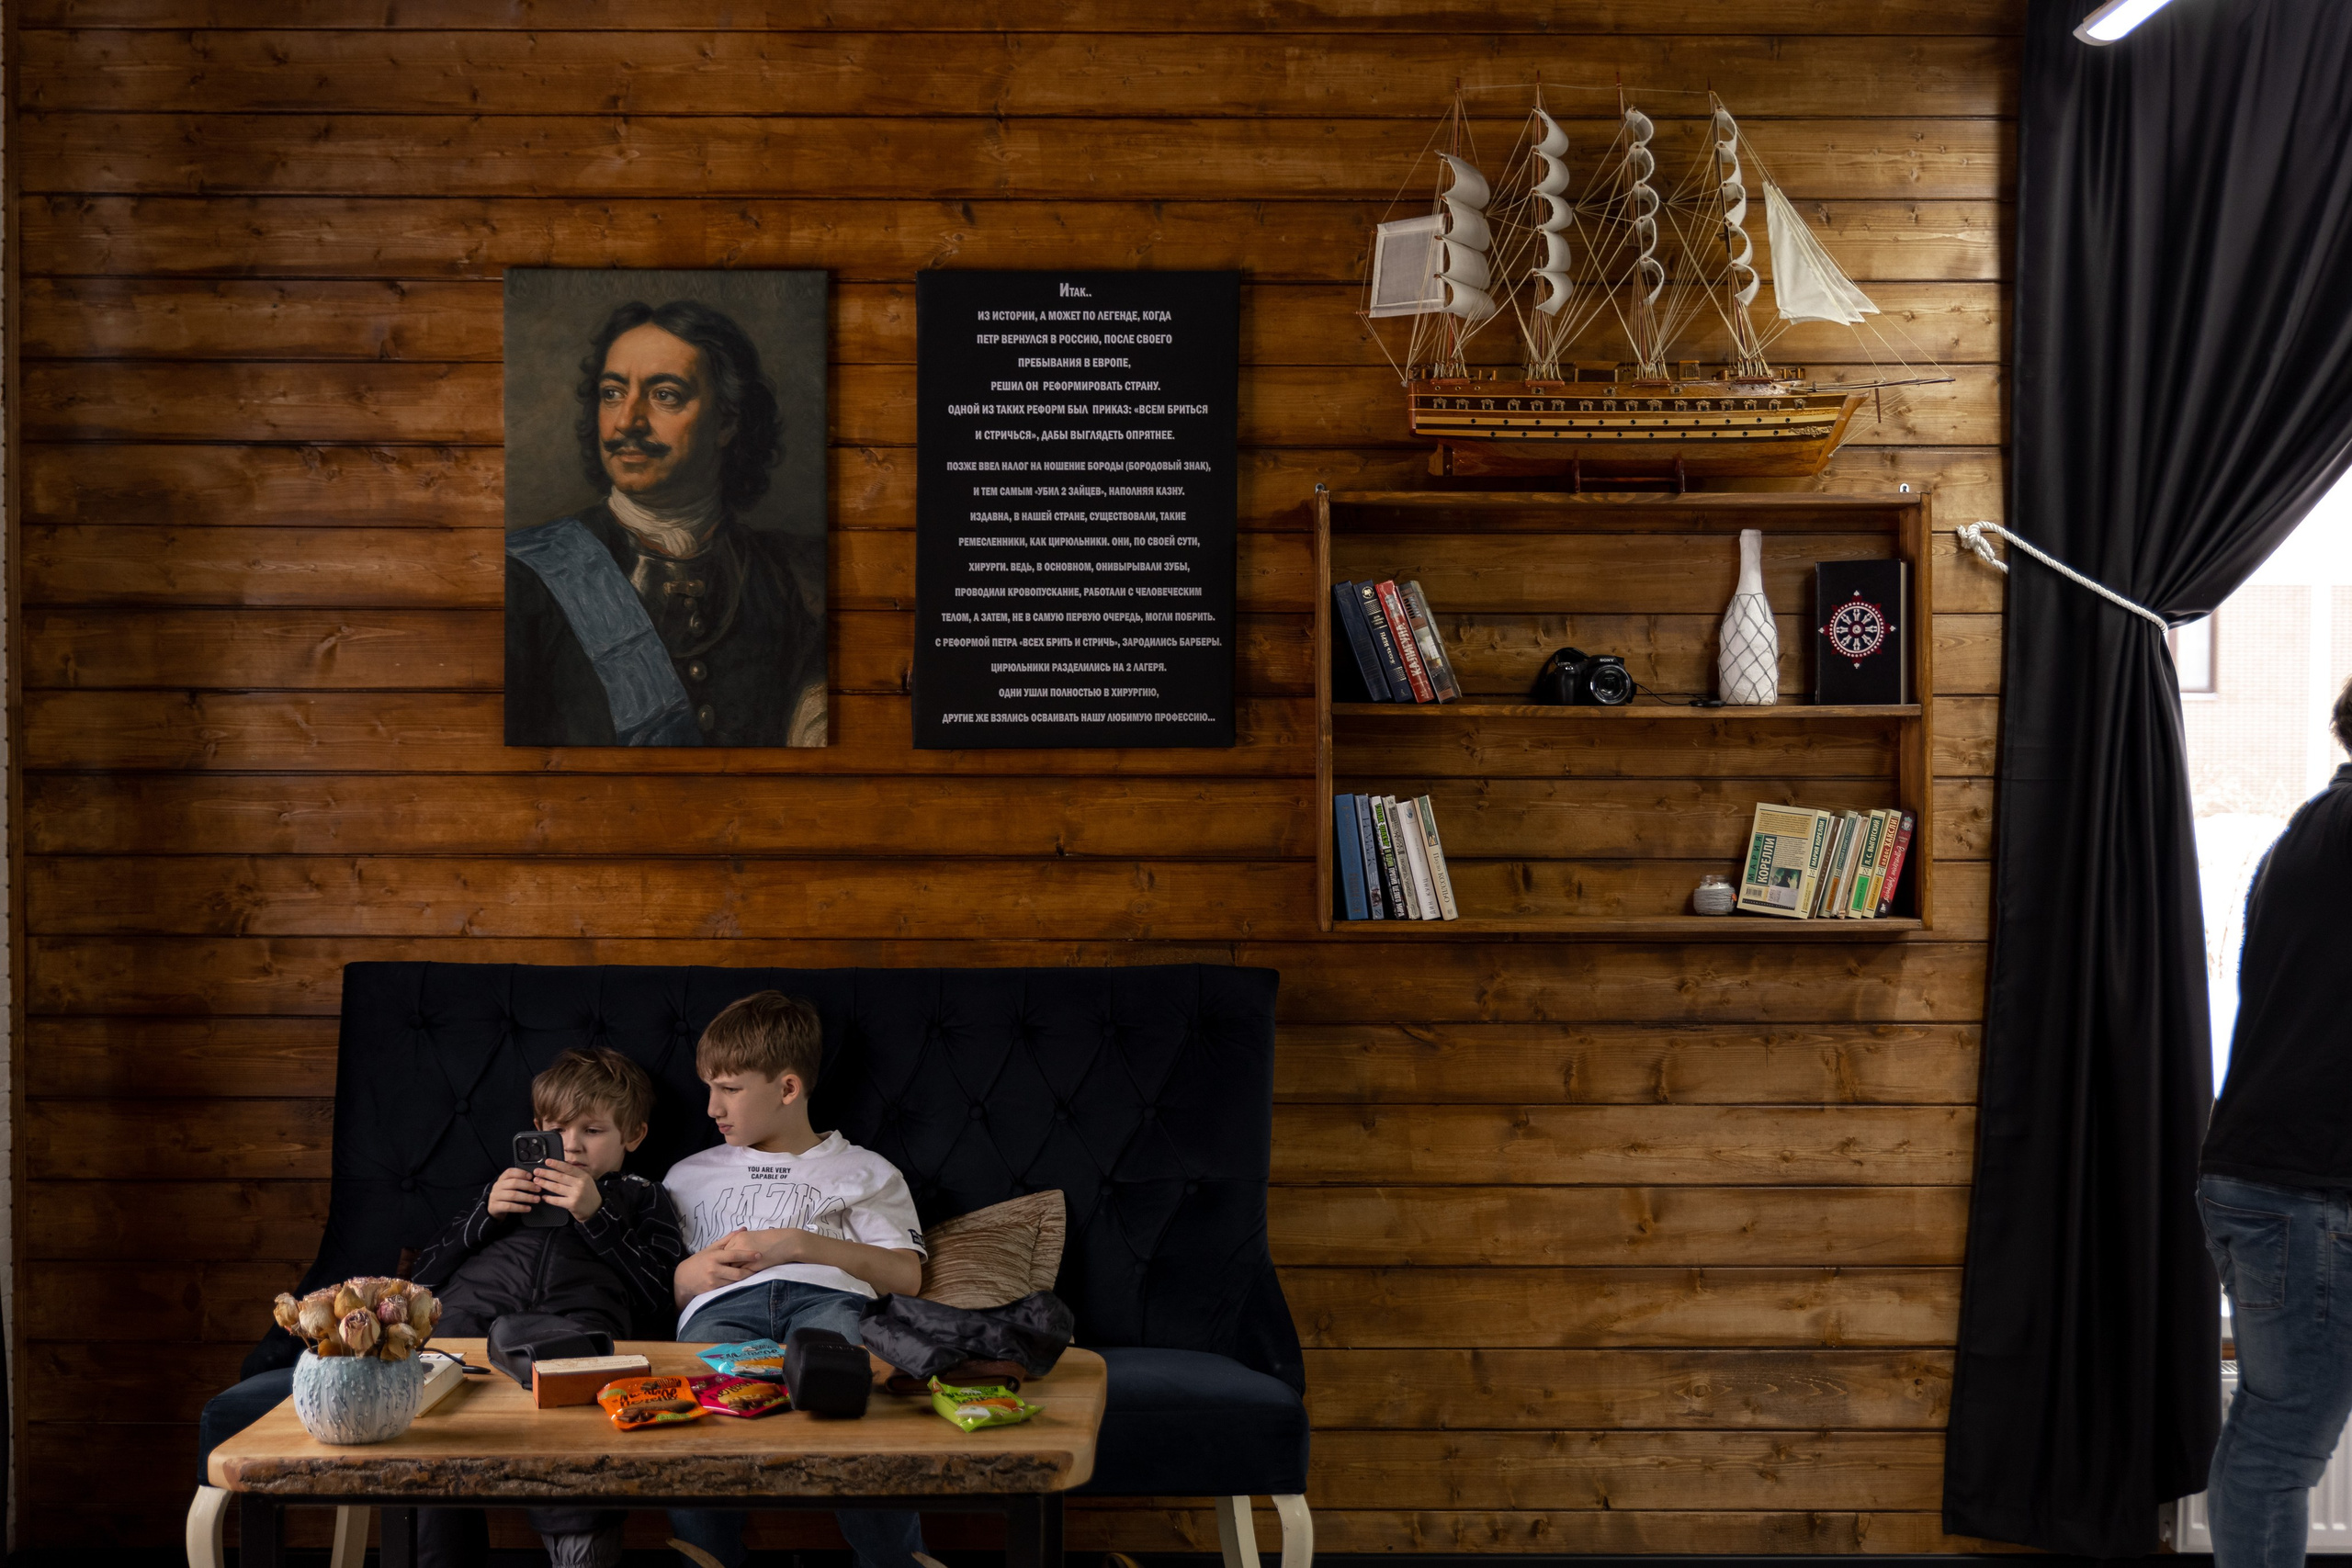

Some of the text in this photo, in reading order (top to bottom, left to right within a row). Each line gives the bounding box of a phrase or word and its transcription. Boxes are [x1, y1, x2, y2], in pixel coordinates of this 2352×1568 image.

[978, 310, 1171, 321] ИЗ ИСТОРИИ, А МОЖЕТ ПО ЛЕГЕНДЕ, КОГДА
[977, 334, 1172, 345] ПЕТР ВЕРНУЛСЯ В РОССИЮ, ПОСЛЕ СВОЕГО
[1018, 357, 1131, 368] ПРЕБЫВАНИЯ В ЕВРОПЕ,
[990, 381, 1161, 391] РЕШИЛ ОН РЕФОРМИРОВАТЬ СТРАНУ.
[948, 402, 1208, 416] ОДНОЙ ИЗ ТАКИХ РЕФОРМ БЫЛ ПРИКАЗ: «ВСЕМ БРИТЬСЯ
[975, 430, 1175, 441] И СТРИЧЬСЯ», ДАБЫ ВЫГЛЯДЕТЬ ОПРЯТНЕЕ.
[946, 459, 1211, 472] ПОЗЖЕ ВВЕЛ НАЛОГ НА НОШЕНИЕ БОРОДЫ (БОРОДОВЫЙ ЗНАК),
[973, 487, 979, 496] И
[981, 487, 998, 496] ТЕМ
[1000, 487, 1033, 496] САМЫМ
[1060, 487, 1067, 496] 2
[1109, 487, 1154, 496] НАПОЛНЯЯ
[1156, 487, 1185, 496] КАЗНУ.
[970, 510, 1186, 523] ИЗДАВНА, В НАШЕЙ СТРАНЕ, СУЩЕСТВОВАЛИ, ТАКИЕ
[958, 535, 1200, 547] РЕМЕСЛЕННИКИ, КАК ЦИРЮЛЬНИКИ. ОНИ, ПО СВОЕЙ СУТИ,
[968, 562, 1009, 571] ХИРУРГИ.
[1011, 562, 1035, 573] ВЕДЬ,
[1036, 562, 1043, 571] В
[1044, 562, 1094, 573] ОСНОВНОМ,
[1163, 562, 1190, 572] ЗУБЫ,
[955, 587, 1202, 598] ПРОВОДИЛИ КРОВОПУСКАНИЕ, РАБОТАЛИ С ЧЕЛОВЕЧЕСКИМ
[941, 612, 1216, 623] ТЕЛОМ, А ЗАТЕМ, НЕ В САМУЮ ПЕРВУЮ ОЧЕРЕДЬ, МОГЛИ ПОБРИТЬ.
[935, 637, 941, 647] С
[943, 636, 990, 647] РЕФОРМОЙ
[992, 637, 1018, 647] ПЕТРА
[1046, 637, 1073, 647] БРИТЬ
[1075, 637, 1080, 647] И
[1122, 637, 1178, 648] ЗАРОДИЛИСЬ
[1180, 637, 1222, 647] БАРБЕРЫ.
[1379, 631, 1389, 647] ВЕРН
[990, 663, 1167, 673] ЦИРЮЛЬНИКИ РАЗДЕЛИЛИСЬ НА 2 ЛАГЕРЯ.
[999, 688, 1159, 698] ОДНИ УШЛИ ПОЛНОСТЬЮ В ХИРУРГИЮ,
[942, 713, 1216, 724] ДРУГИЕ ЖЕ ВЗЯЛИСЬ ОСВАИВАТЬ НАШУ ЛЮБИМУЮ ПРОФЕССИЮ...
[1866, 819, 1880, 852] ВЫГОТСКИЙ
[1884, 818, 1897, 847] ХАКСЛИ
[1810, 820, 1825, 866] МАРИЯ КОРЕЛЛИ
[1747, 835, 1762, 881] МАРИЯ
[1757, 837, 1775, 883] КОРЕЛЛИ
[1433, 852, 1450, 903] Пауло КОЭЛЬО
[1388, 867, 1397, 886] ПРОТИВ
[1396, 903, 1405, 918] МИРА
[1423, 878, 1431, 896] КУНЦ
